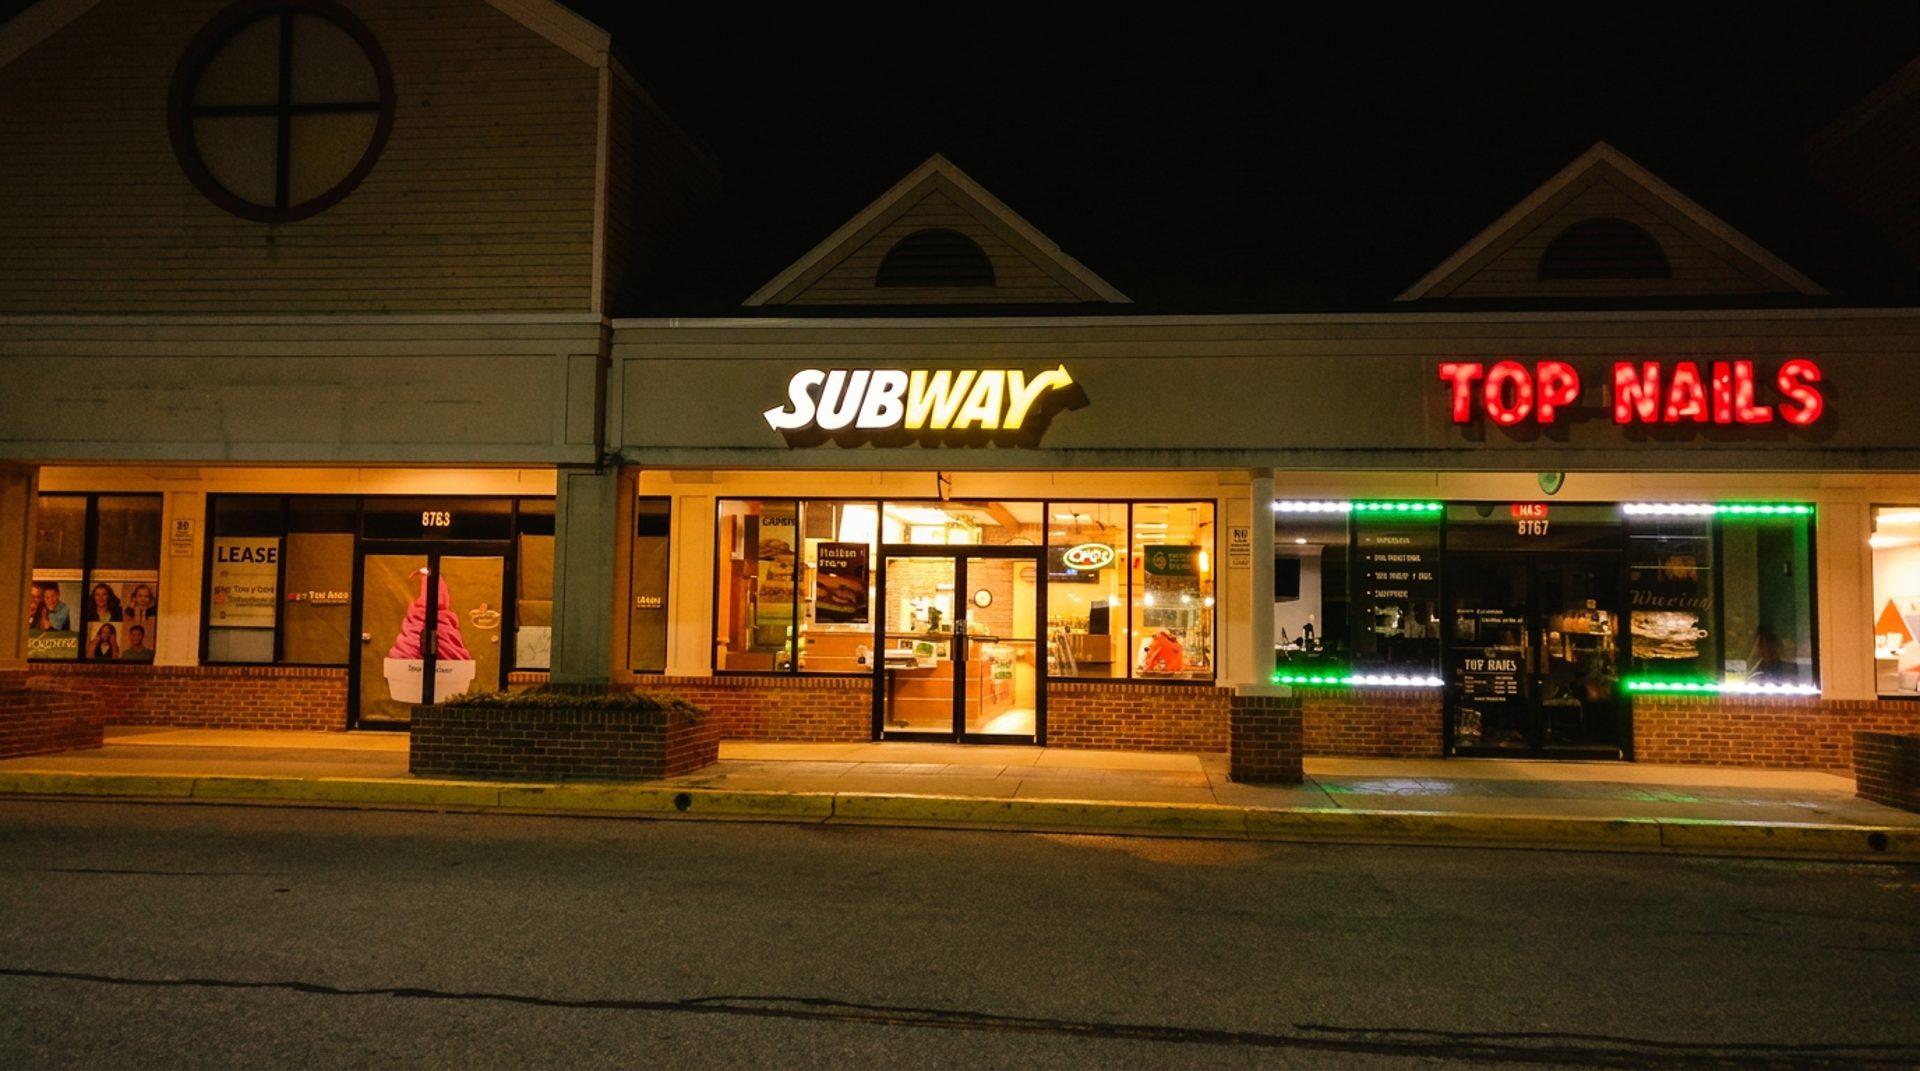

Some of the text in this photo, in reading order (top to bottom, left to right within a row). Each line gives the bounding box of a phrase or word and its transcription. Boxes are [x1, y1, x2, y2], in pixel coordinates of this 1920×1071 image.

[763, 364, 1073, 431] SUBWAY
[1439, 359, 1824, 425] TOP NAILS
[422, 511, 450, 526] 8763
[217, 546, 277, 563] LEASE
